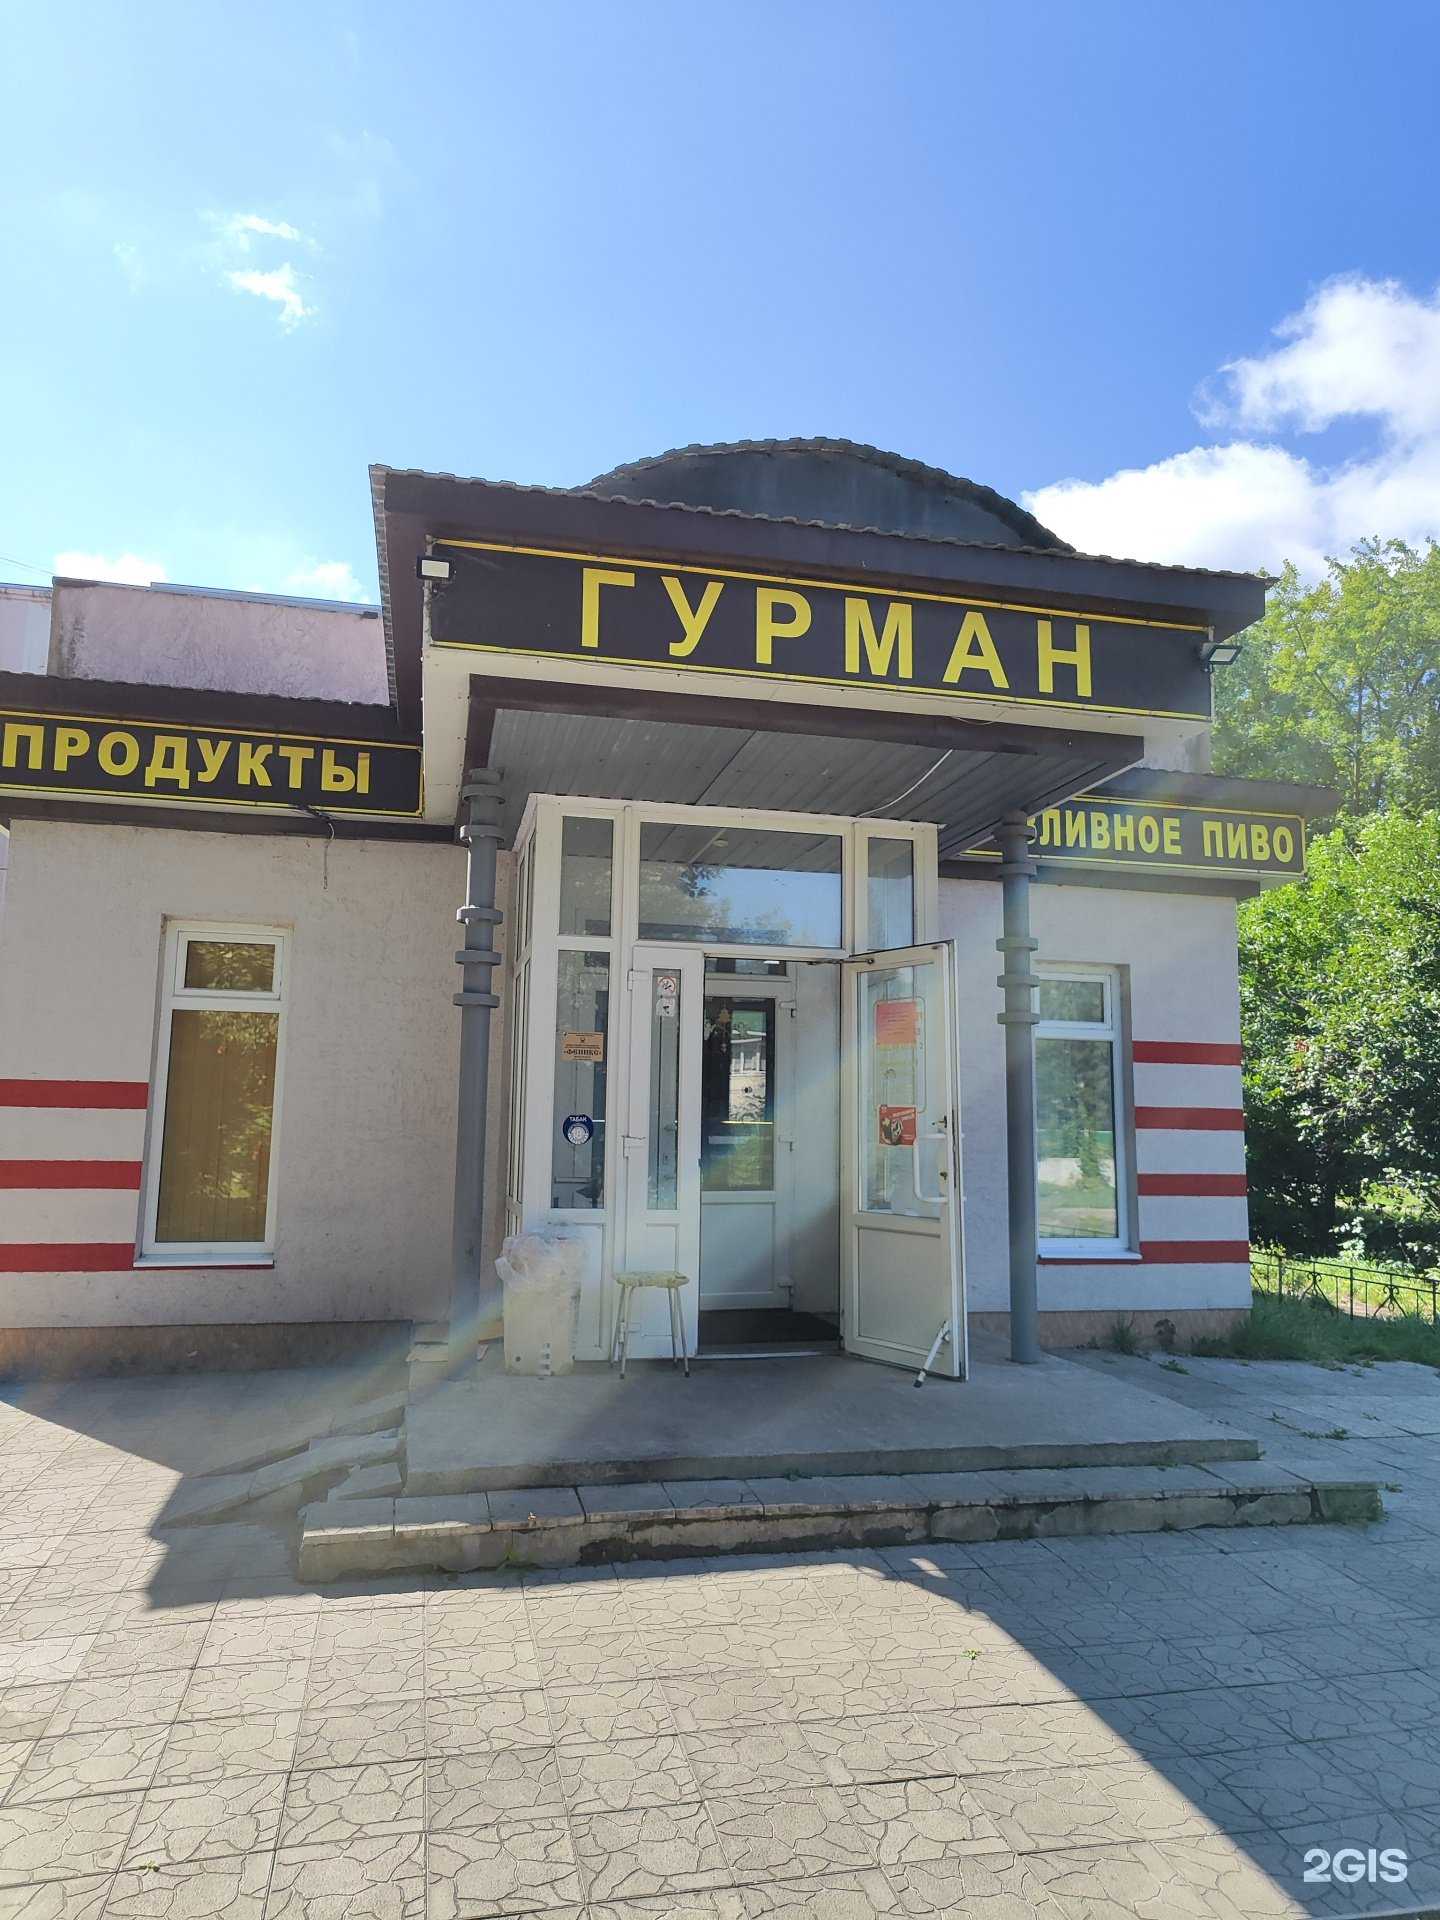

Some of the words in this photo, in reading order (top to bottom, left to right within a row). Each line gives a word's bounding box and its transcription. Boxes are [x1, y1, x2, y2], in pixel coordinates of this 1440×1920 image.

[580, 567, 1093, 697] ГУРМАН
[2, 722, 371, 795] ПРОДУКТЫ
[1202, 820, 1295, 864] ПИВО
